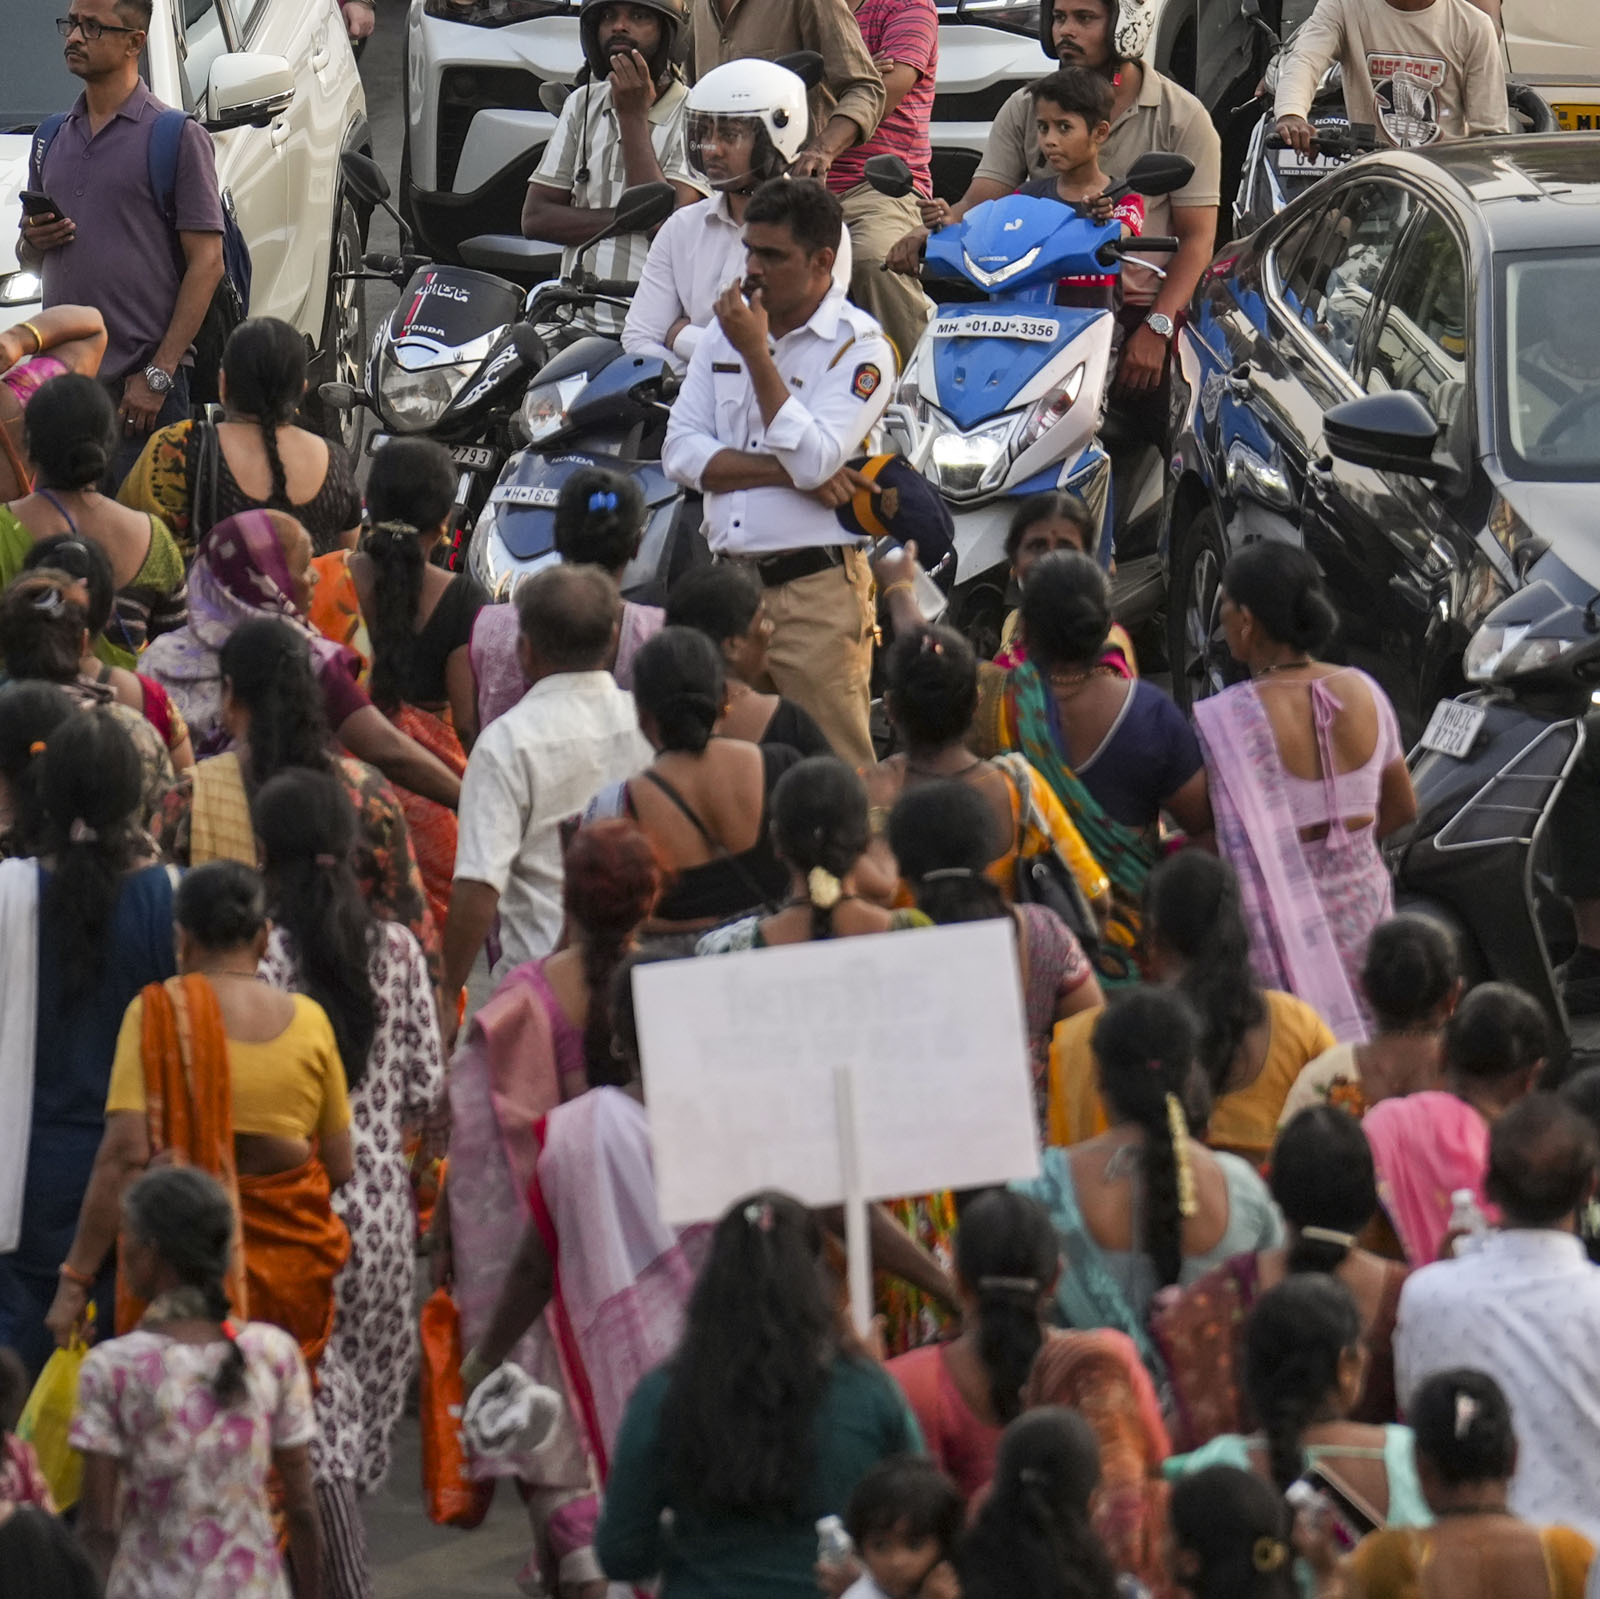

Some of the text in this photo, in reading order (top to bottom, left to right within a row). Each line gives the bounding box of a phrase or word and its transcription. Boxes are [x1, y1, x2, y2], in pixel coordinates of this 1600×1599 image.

[1371, 59, 1439, 80] DISC GOLF
[1314, 118, 1350, 127] HOND
[403, 324, 445, 336] HONDA
[551, 455, 595, 467] HONDA
